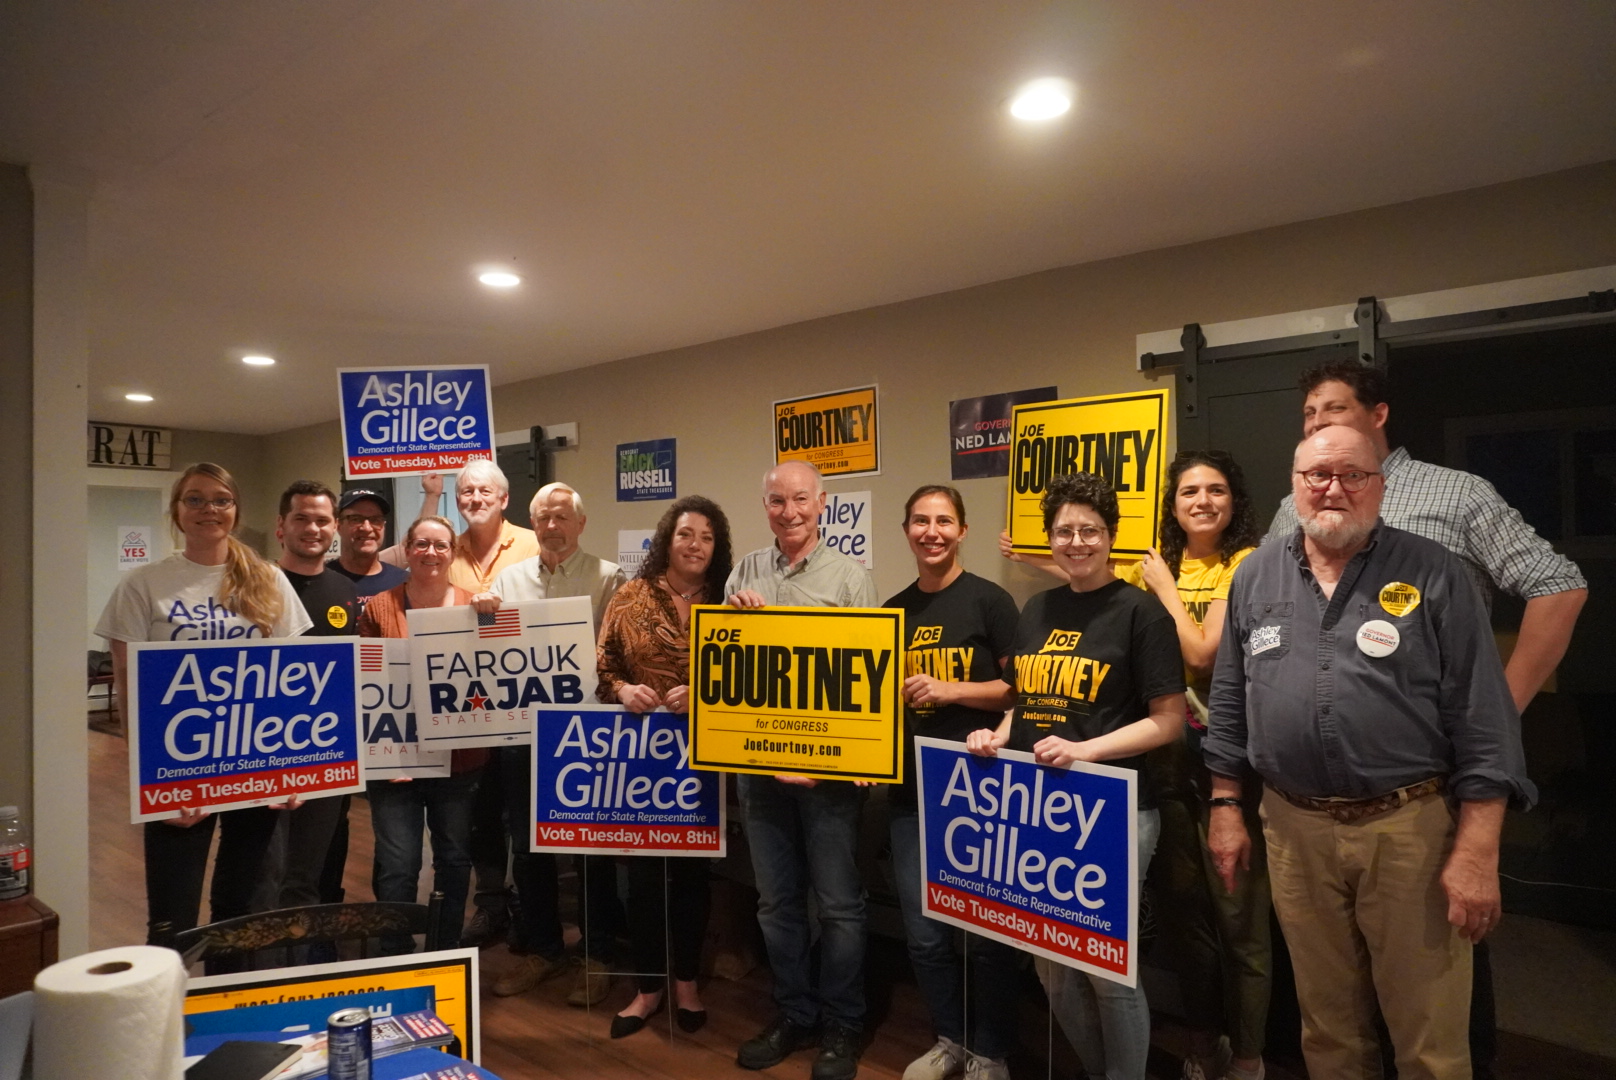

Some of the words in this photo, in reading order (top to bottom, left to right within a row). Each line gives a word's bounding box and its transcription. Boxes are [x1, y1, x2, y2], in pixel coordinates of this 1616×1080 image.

[357, 372, 473, 411] Ashley
[778, 406, 796, 417] JOE
[360, 408, 477, 444] Gillece
[778, 403, 872, 452] COURTNEY
[1019, 423, 1045, 438] JOE
[358, 446, 395, 454] Democrat
[396, 445, 407, 453] for
[408, 444, 427, 452] State
[428, 441, 481, 451] Representative
[955, 434, 985, 450] NED
[351, 459, 381, 471] Vote
[383, 457, 437, 469] Tuesday,
[439, 455, 465, 465] Nov.
[620, 452, 655, 472] ERICK
[814, 450, 844, 460] CONGRESS
[1015, 429, 1156, 494] COURTNEY
[620, 468, 672, 490] RUSSELL
[649, 486, 673, 494] TREASURER
[818, 495, 865, 529] hley
[123, 547, 146, 558] YES
[1382, 590, 1417, 604] COURTNEY
[704, 628, 742, 643] JOE
[914, 628, 941, 642] JOE
[1047, 633, 1079, 647] JOE
[1251, 626, 1280, 639] Ashley
[1365, 628, 1396, 640] GOVERNOR
[1372, 635, 1396, 647] LAMONT
[1252, 635, 1280, 650] Gillece
[426, 643, 581, 681] FAROUK
[160, 649, 336, 705] Ashley
[700, 642, 892, 714] COURTNEY
[1014, 654, 1111, 703] COURTNEY
[429, 673, 584, 715] RAJAB
[1026, 697, 1037, 706] for
[432, 713, 492, 726] STATE
[756, 718, 769, 729] for
[772, 719, 829, 733] CONGRESS
[164, 703, 339, 762] Gillece
[554, 715, 690, 770] Ashley
[743, 738, 842, 757] JoeCourtney.com
[157, 765, 216, 779] Democrat
[218, 761, 236, 774] for
[237, 758, 266, 770] State
[268, 749, 344, 767] Representative
[144, 787, 192, 806] Vote
[197, 778, 278, 800] Tuesday,
[282, 771, 320, 789] Nov.
[323, 766, 356, 783] 8th!
[555, 762, 703, 810] Gillece
[940, 757, 1106, 851] Ashley
[549, 810, 594, 820] Democrat
[596, 811, 608, 822] for
[611, 811, 635, 822] State
[637, 811, 707, 823] Representative
[539, 827, 575, 841] Vote
[579, 828, 645, 845] Tuesday,
[648, 830, 683, 844] Nov.
[686, 830, 717, 844] 8th!
[944, 816, 1107, 909] Gillece
[939, 869, 985, 894] Democrat
[986, 883, 1001, 897] for
[1002, 887, 1029, 907] State
[1030, 896, 1112, 932] Representative
[931, 887, 966, 913] Vote
[969, 899, 1039, 941] Tuesday,
[1043, 923, 1083, 952] Nov.
[1087, 937, 1125, 966] 8th!
